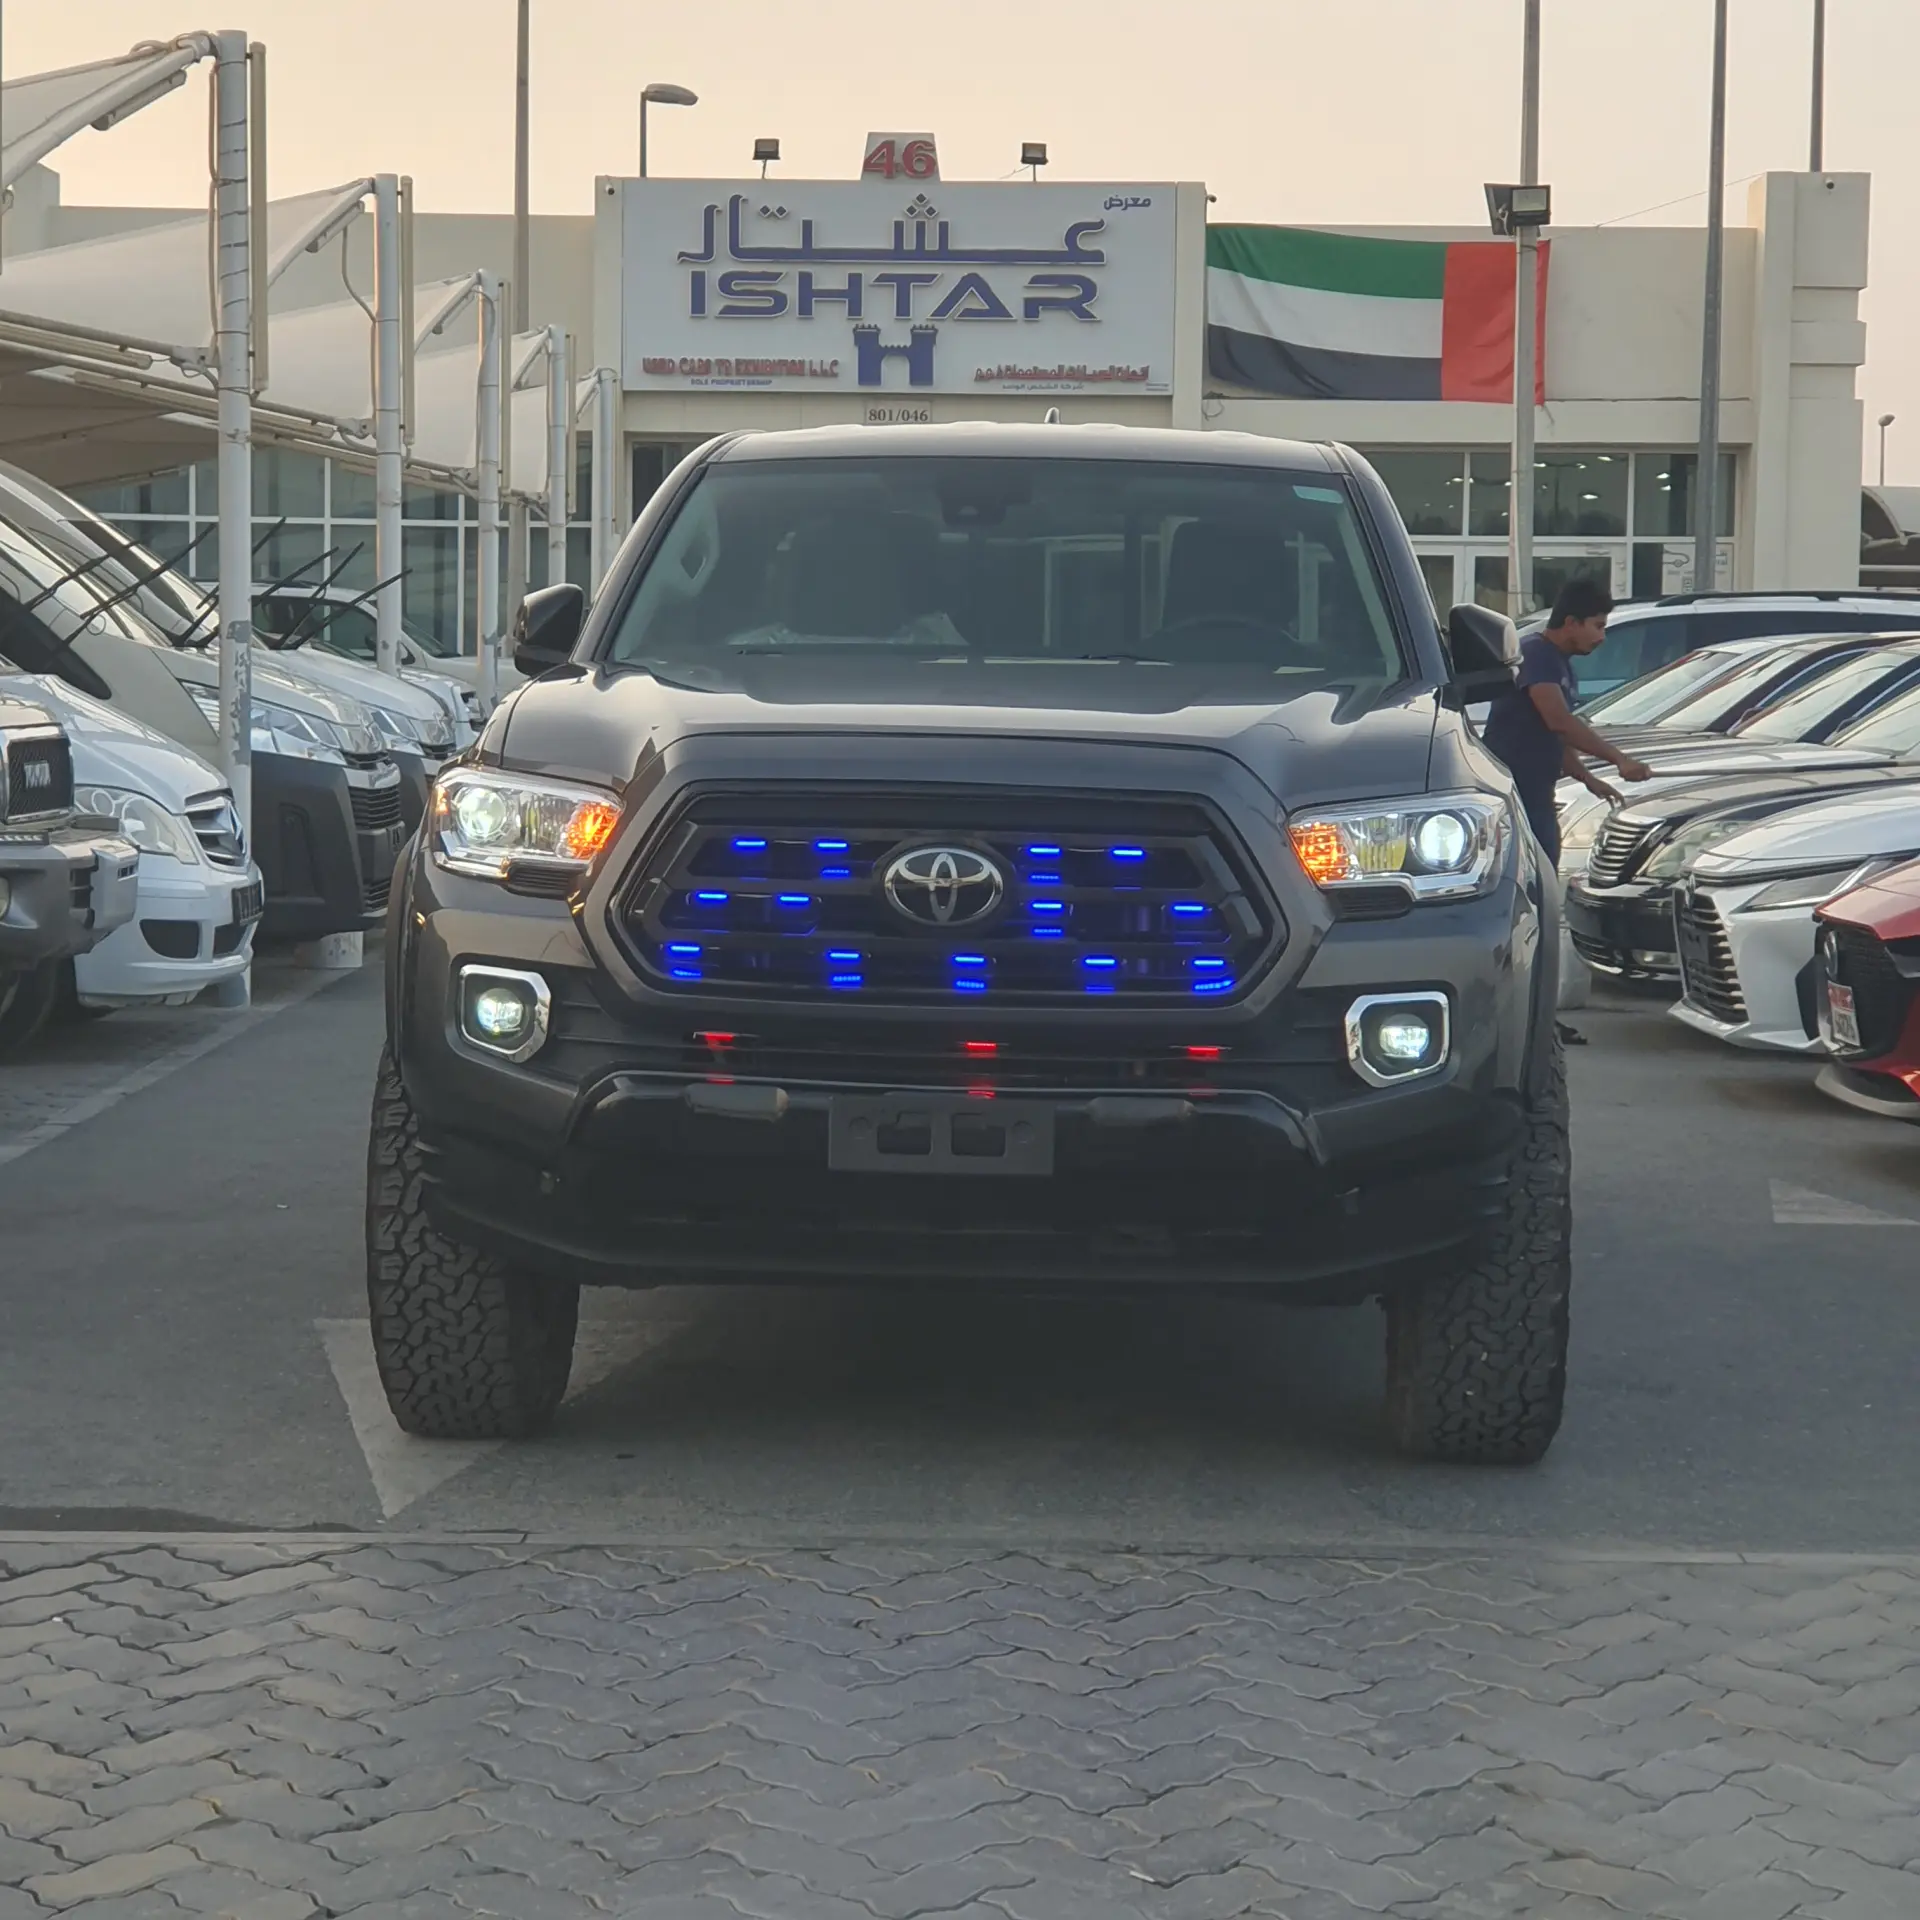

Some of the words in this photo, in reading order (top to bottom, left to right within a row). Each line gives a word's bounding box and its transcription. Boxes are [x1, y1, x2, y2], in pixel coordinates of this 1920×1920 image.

[863, 138, 937, 180] 46
[1103, 194, 1151, 212] معرض
[677, 193, 1106, 264] عشتار
[689, 269, 1102, 322] ISHTAR
[868, 408, 929, 422] 801/046
